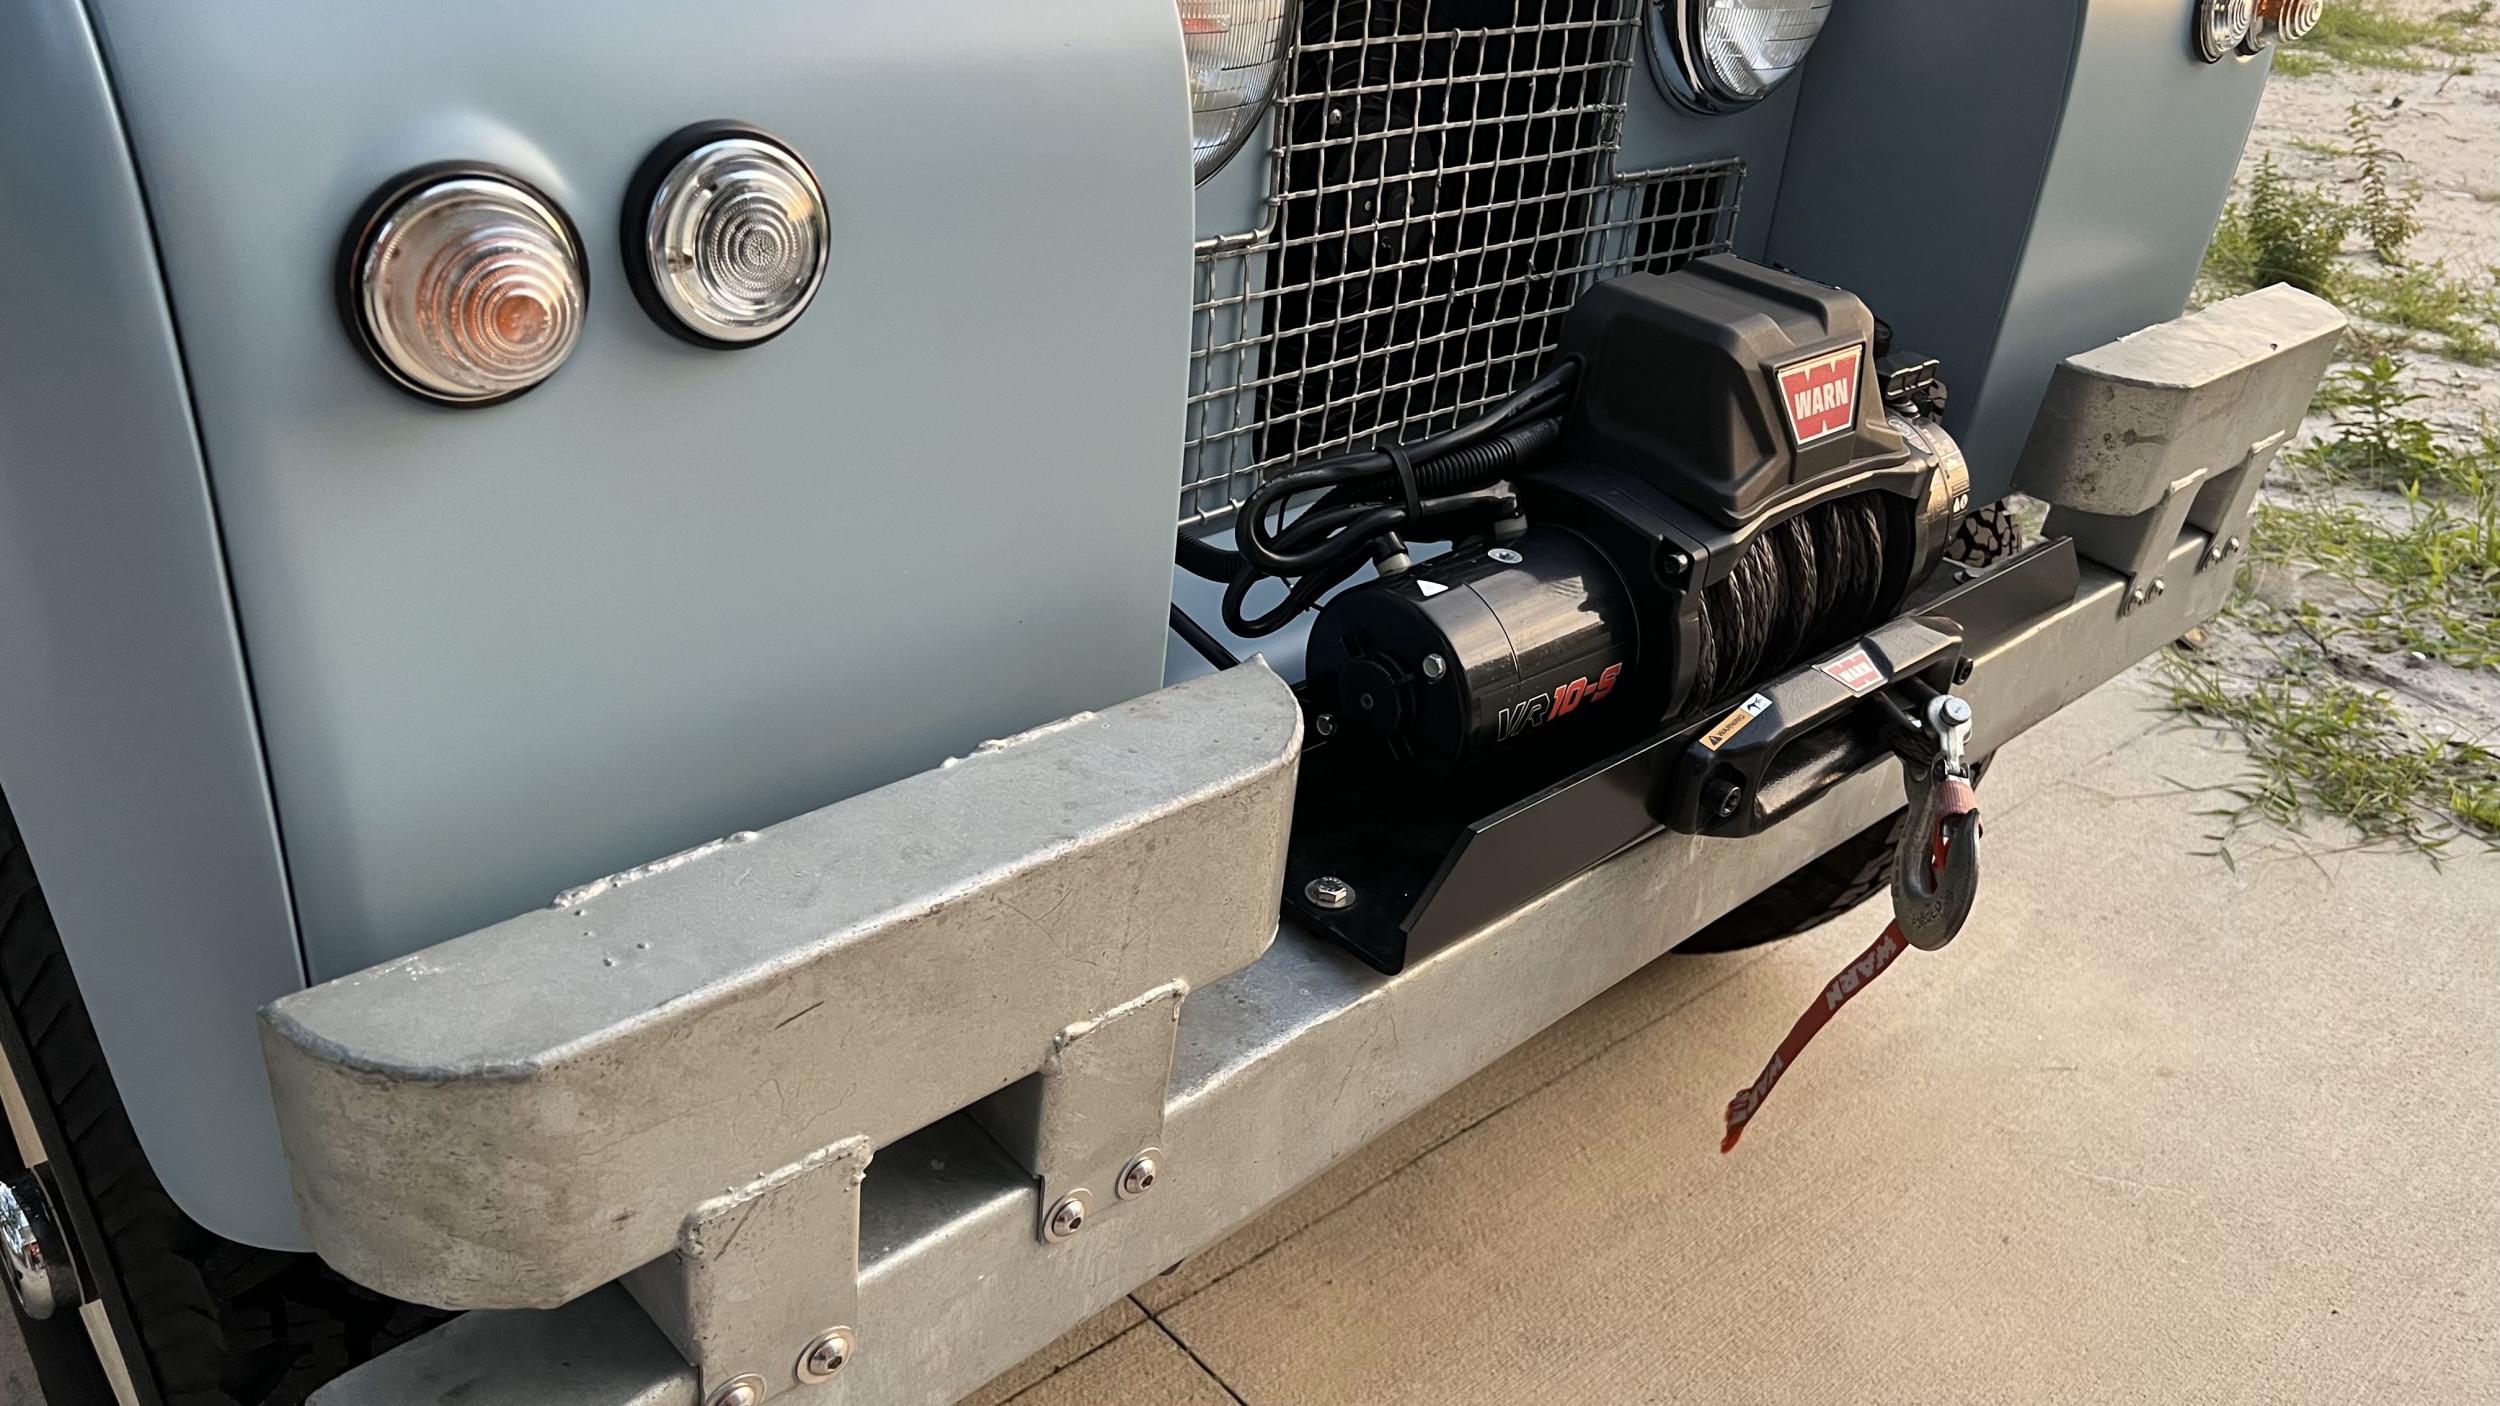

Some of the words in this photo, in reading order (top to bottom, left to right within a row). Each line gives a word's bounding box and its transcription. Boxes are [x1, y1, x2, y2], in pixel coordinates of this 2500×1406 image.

[1793, 378, 1849, 421] WARN
[1717, 713, 1746, 737] WARNING
[1825, 934, 1897, 1011] WARN
